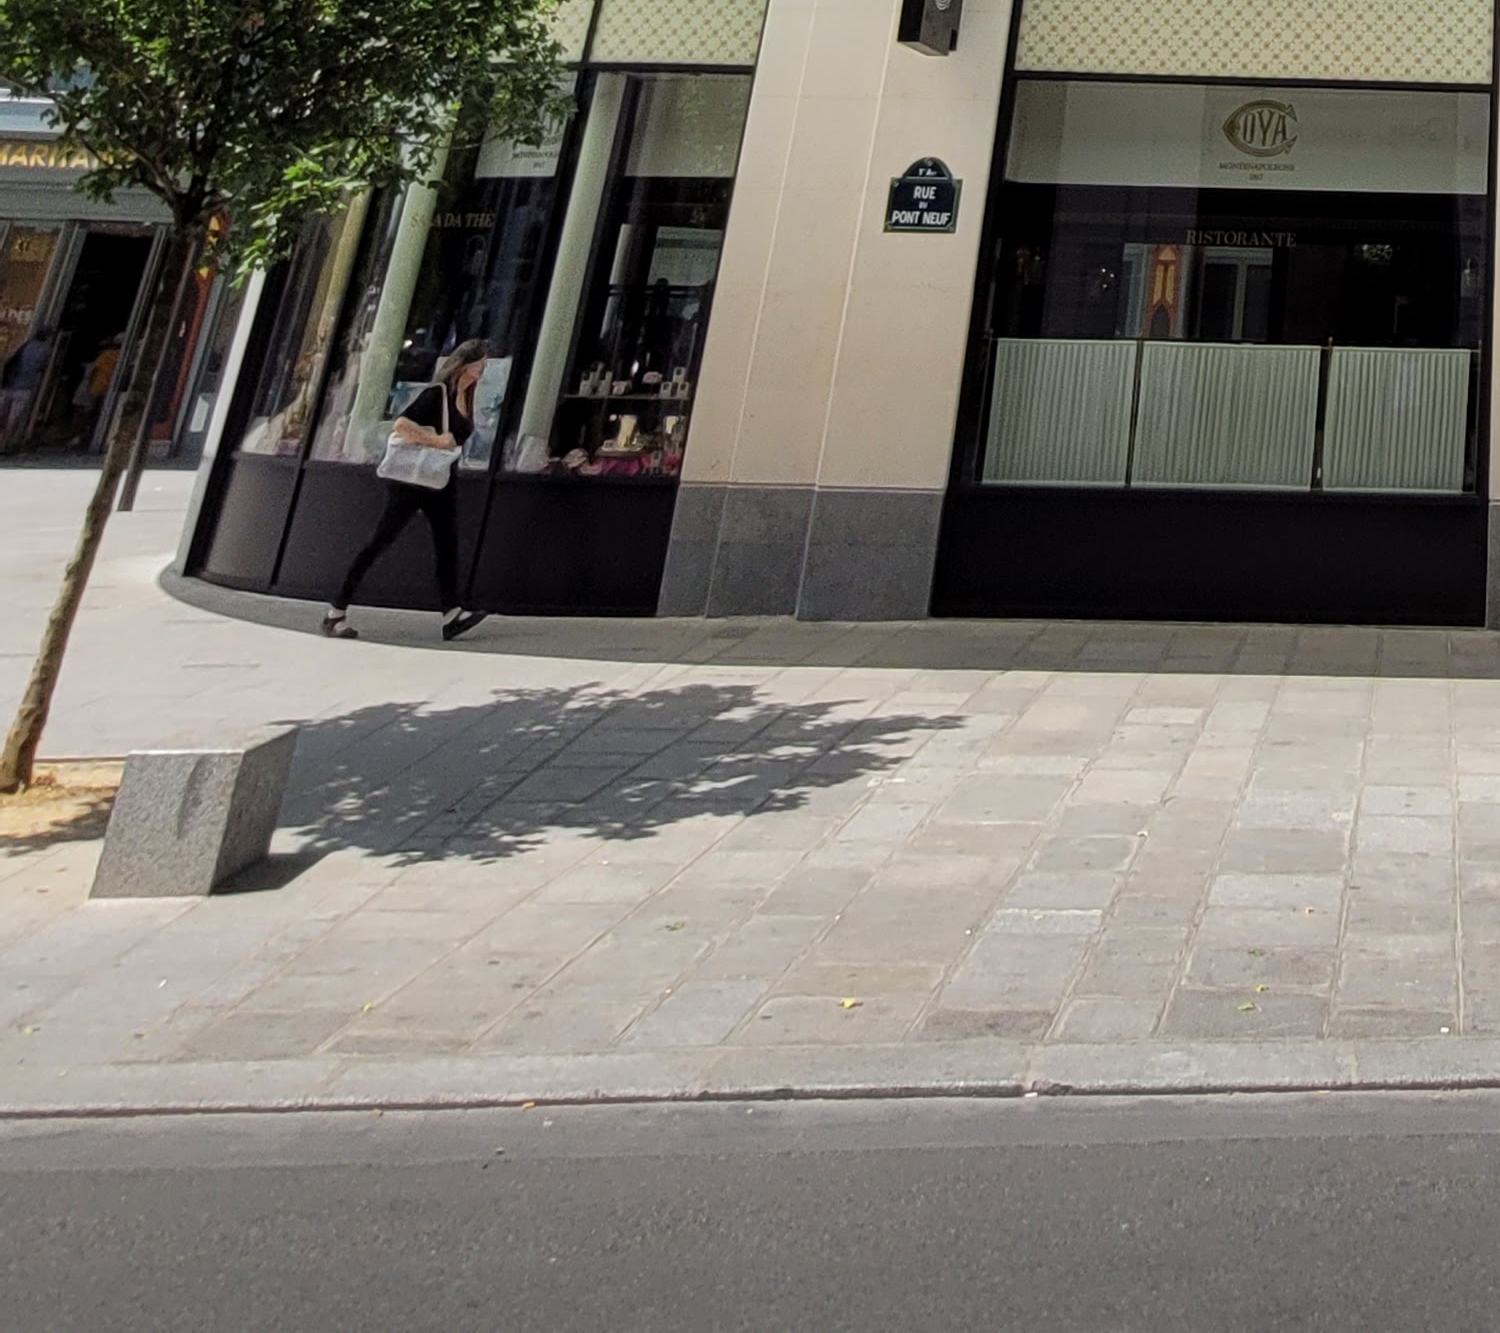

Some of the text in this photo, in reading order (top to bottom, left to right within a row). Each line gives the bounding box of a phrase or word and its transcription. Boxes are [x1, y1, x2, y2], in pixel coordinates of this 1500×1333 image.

[913, 186, 937, 200] RUE
[892, 211, 951, 225] PONT NEUF
[1185, 229, 1298, 247] RISTORANTE
